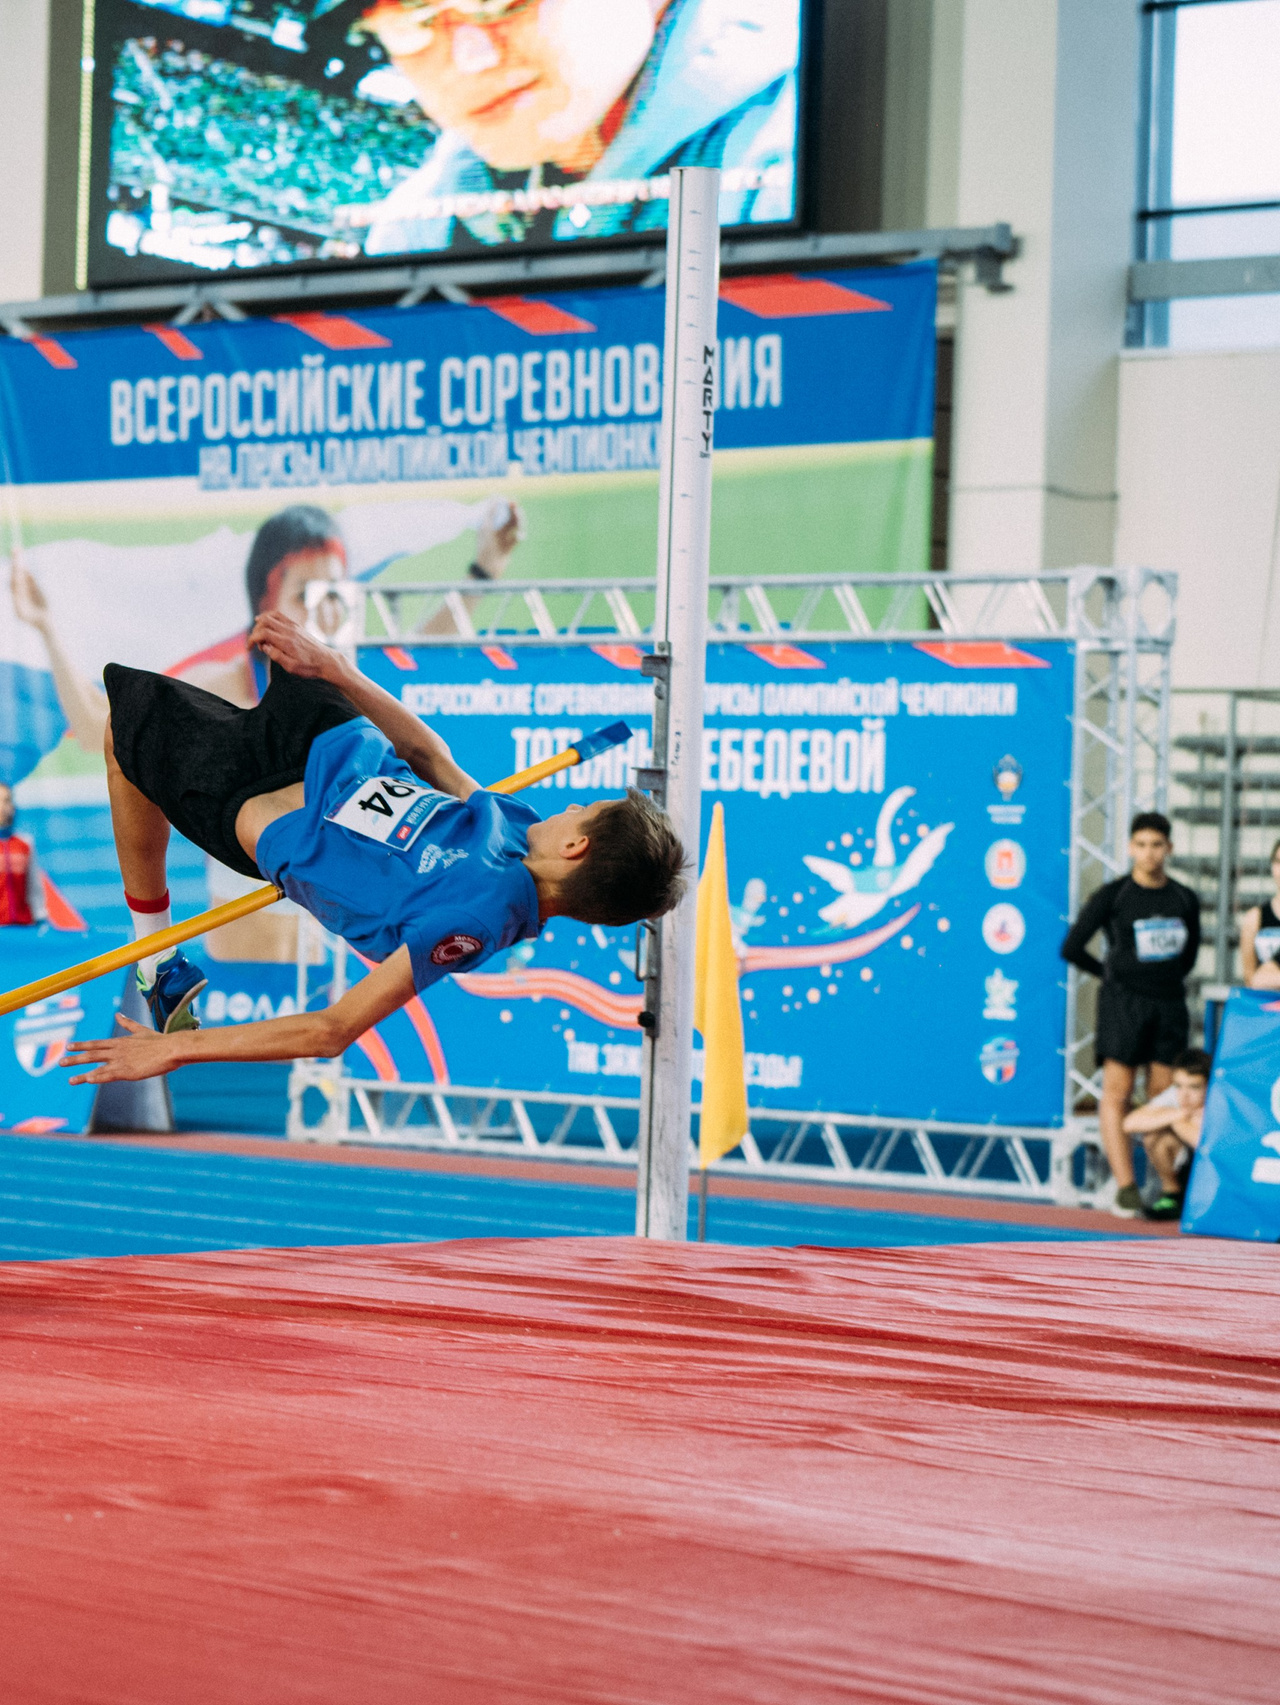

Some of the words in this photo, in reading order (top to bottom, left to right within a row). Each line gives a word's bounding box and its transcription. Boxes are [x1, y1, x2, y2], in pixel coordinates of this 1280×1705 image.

[110, 353, 427, 446] ВСЕРОССИЙСКИЕ
[439, 333, 783, 427] СОРЕВНОВИЯ
[513, 421, 662, 478] ЧЕМПИОНК
[701, 717, 886, 799] ЕБЕДЕВОЙ
